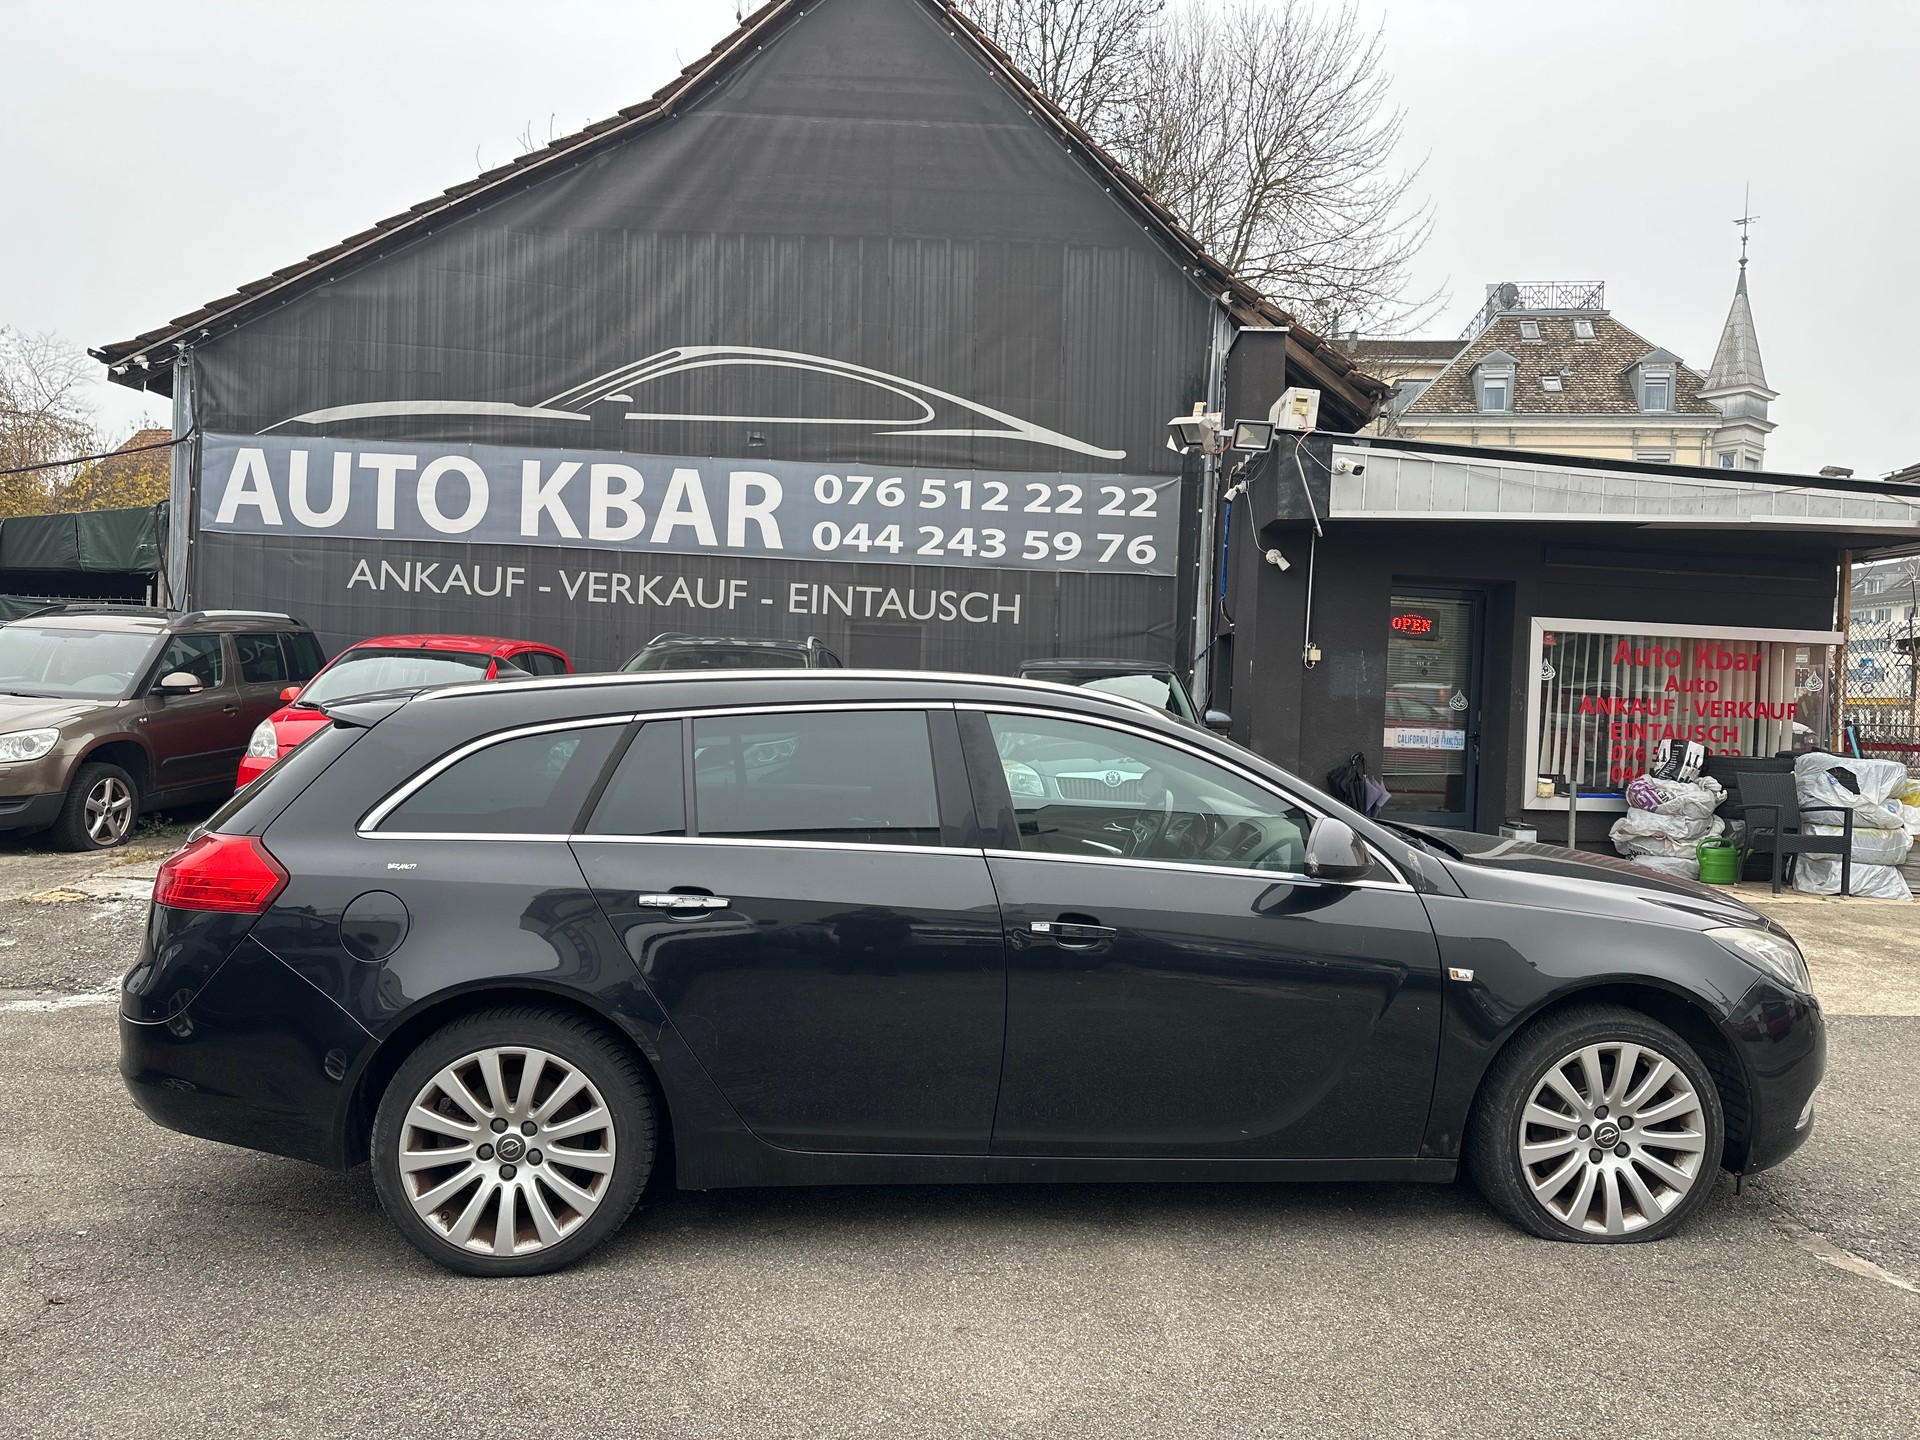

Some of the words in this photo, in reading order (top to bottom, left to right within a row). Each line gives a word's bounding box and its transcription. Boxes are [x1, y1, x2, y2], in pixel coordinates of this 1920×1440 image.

[215, 447, 490, 534] AUTO
[520, 459, 785, 550] KBAR
[813, 473, 906, 508] 076
[917, 478, 1009, 512] 512
[1022, 482, 1083, 515] 22
[1097, 486, 1158, 518] 22
[812, 520, 904, 554] 044
[917, 525, 1007, 559] 243
[1021, 530, 1083, 562] 59
[1096, 533, 1157, 565] 76
[346, 558, 525, 598] ANKAUF
[558, 569, 748, 611] VERKAUF
[789, 582, 1021, 625] EINTAUSCH
[1391, 617, 1433, 632] OPEN
[1613, 640, 1682, 668] Auto
[1696, 643, 1763, 672] Kbar
[1664, 674, 1719, 693] Auto
[1578, 696, 1675, 716] ANKAUF
[1695, 699, 1799, 720] VERKAUF
[1397, 734, 1429, 745] CALIFORNIA
[1431, 737, 1439, 745] SAN
[1610, 722, 1738, 743] EINTAUSCH
[1611, 744, 1647, 763] 076
